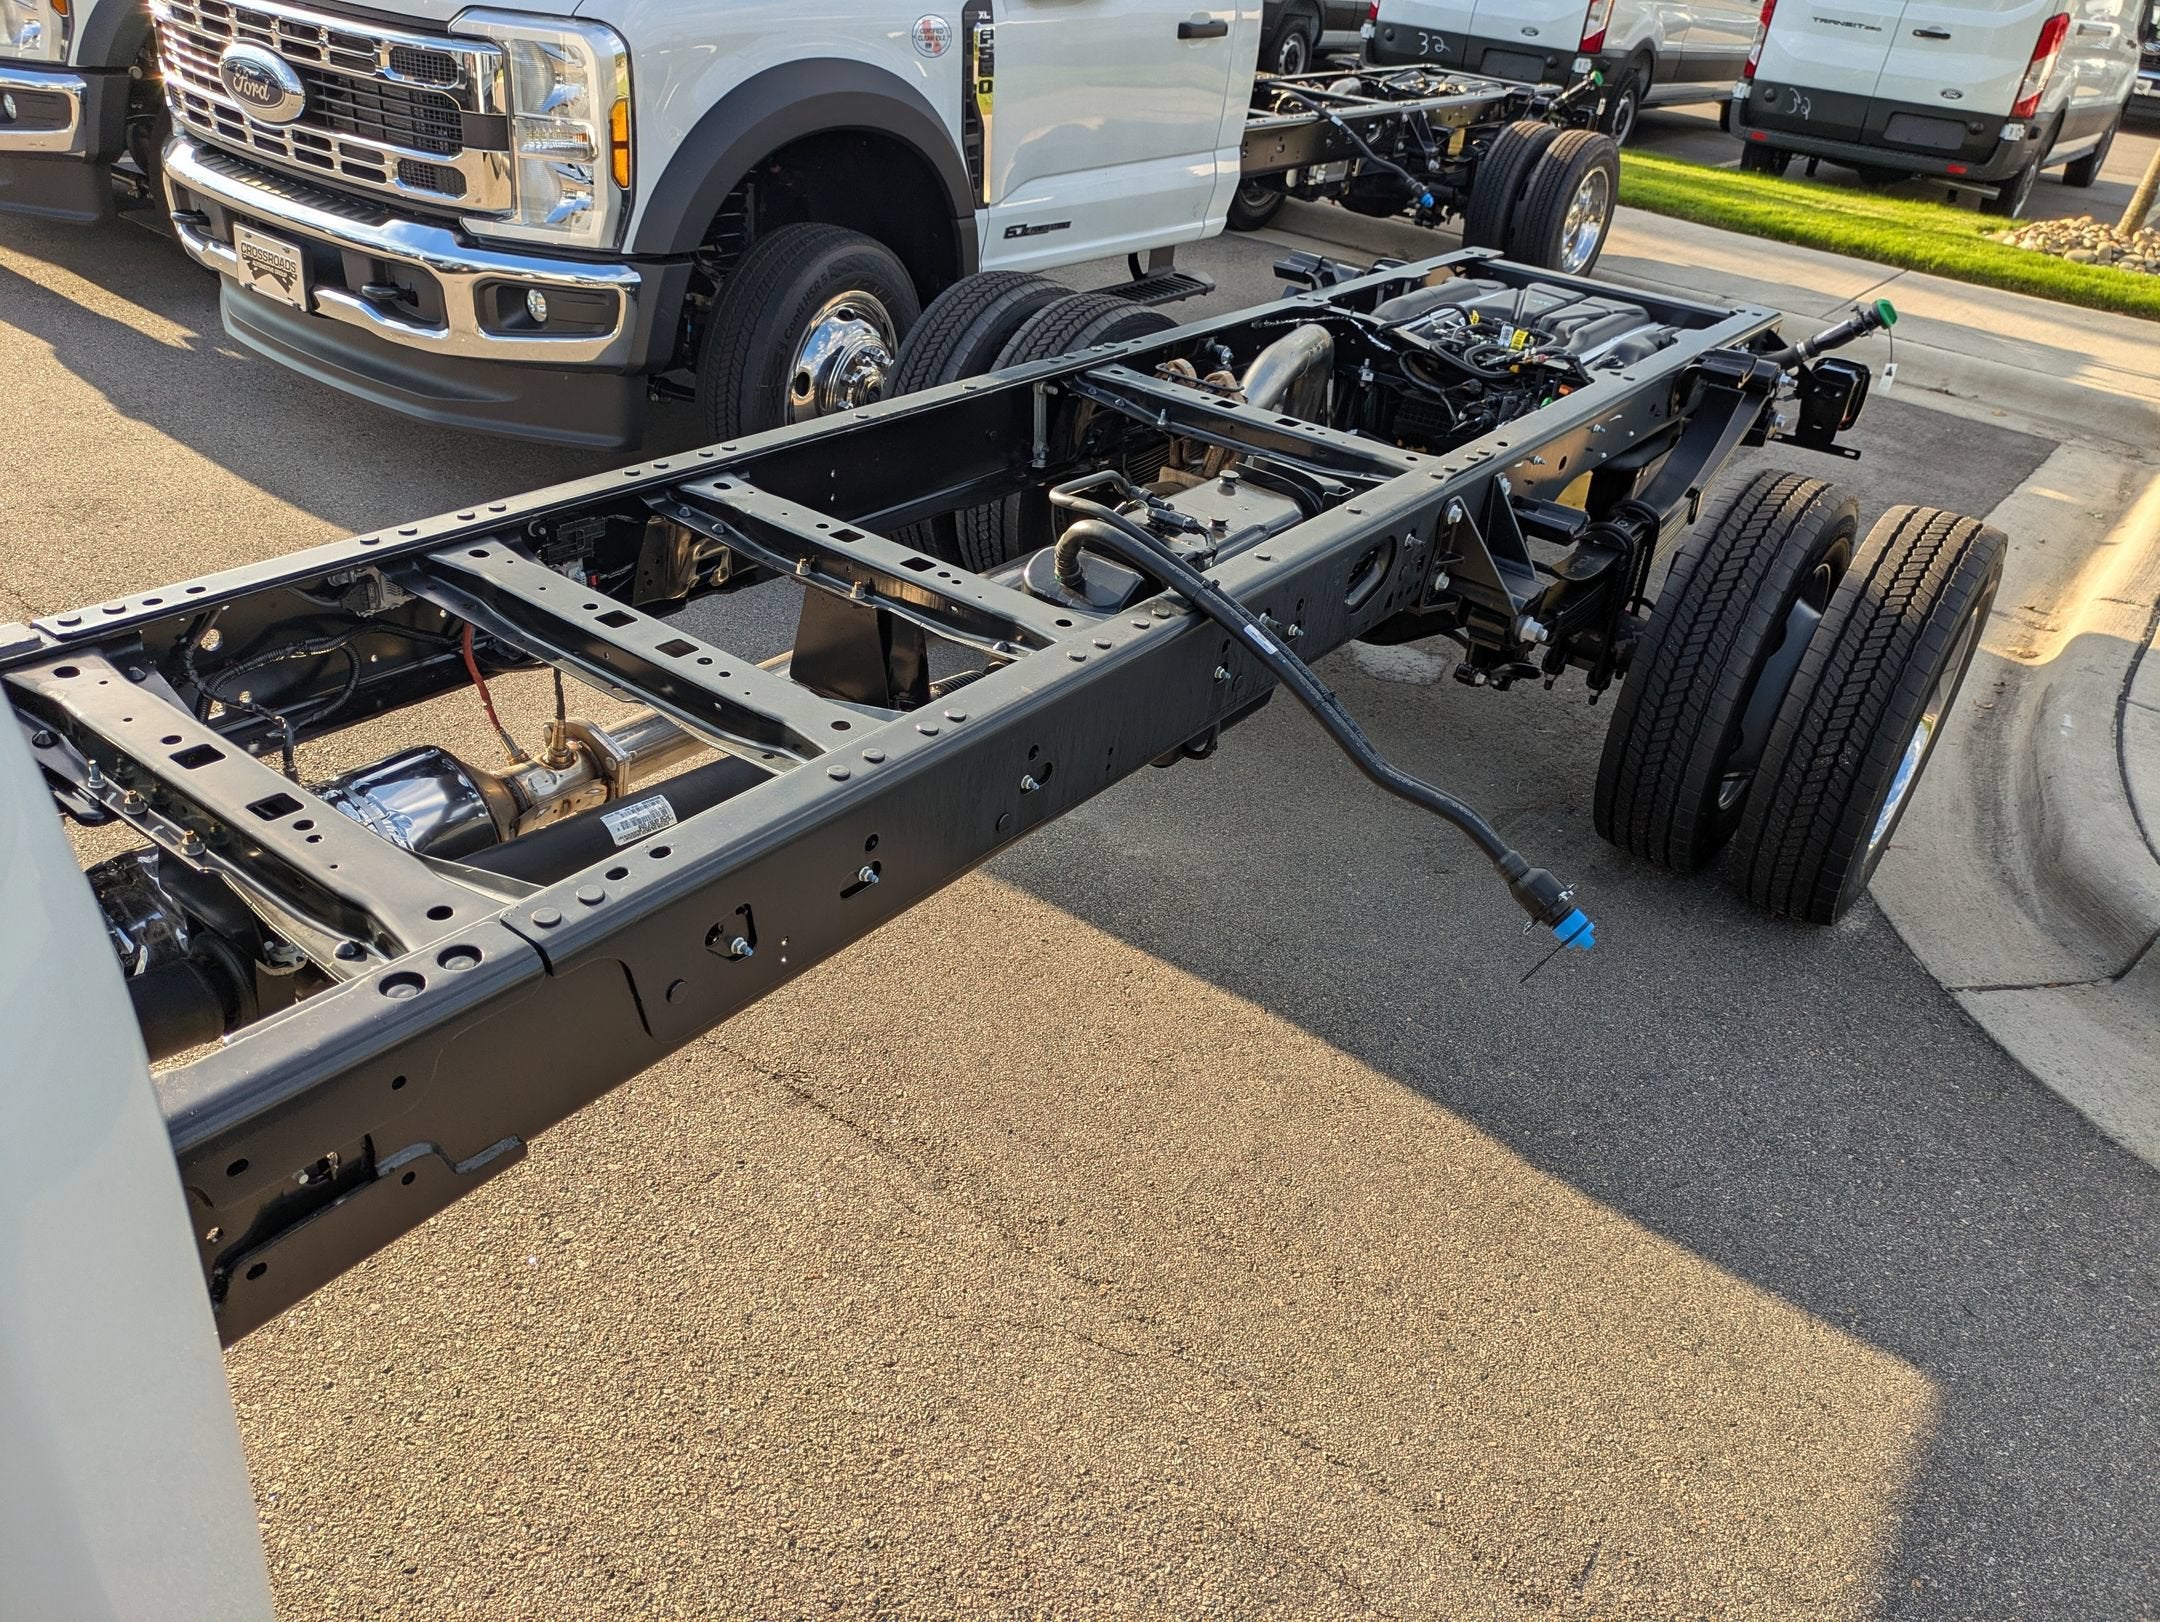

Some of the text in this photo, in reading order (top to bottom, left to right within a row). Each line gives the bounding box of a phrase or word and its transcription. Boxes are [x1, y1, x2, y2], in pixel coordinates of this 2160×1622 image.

[978, 10, 991, 20] XL
[1812, 16, 1865, 29] TRANSIT
[1418, 32, 1451, 56] 32
[233, 72, 270, 101] Ford
[240, 242, 297, 273] CROSSROADS
